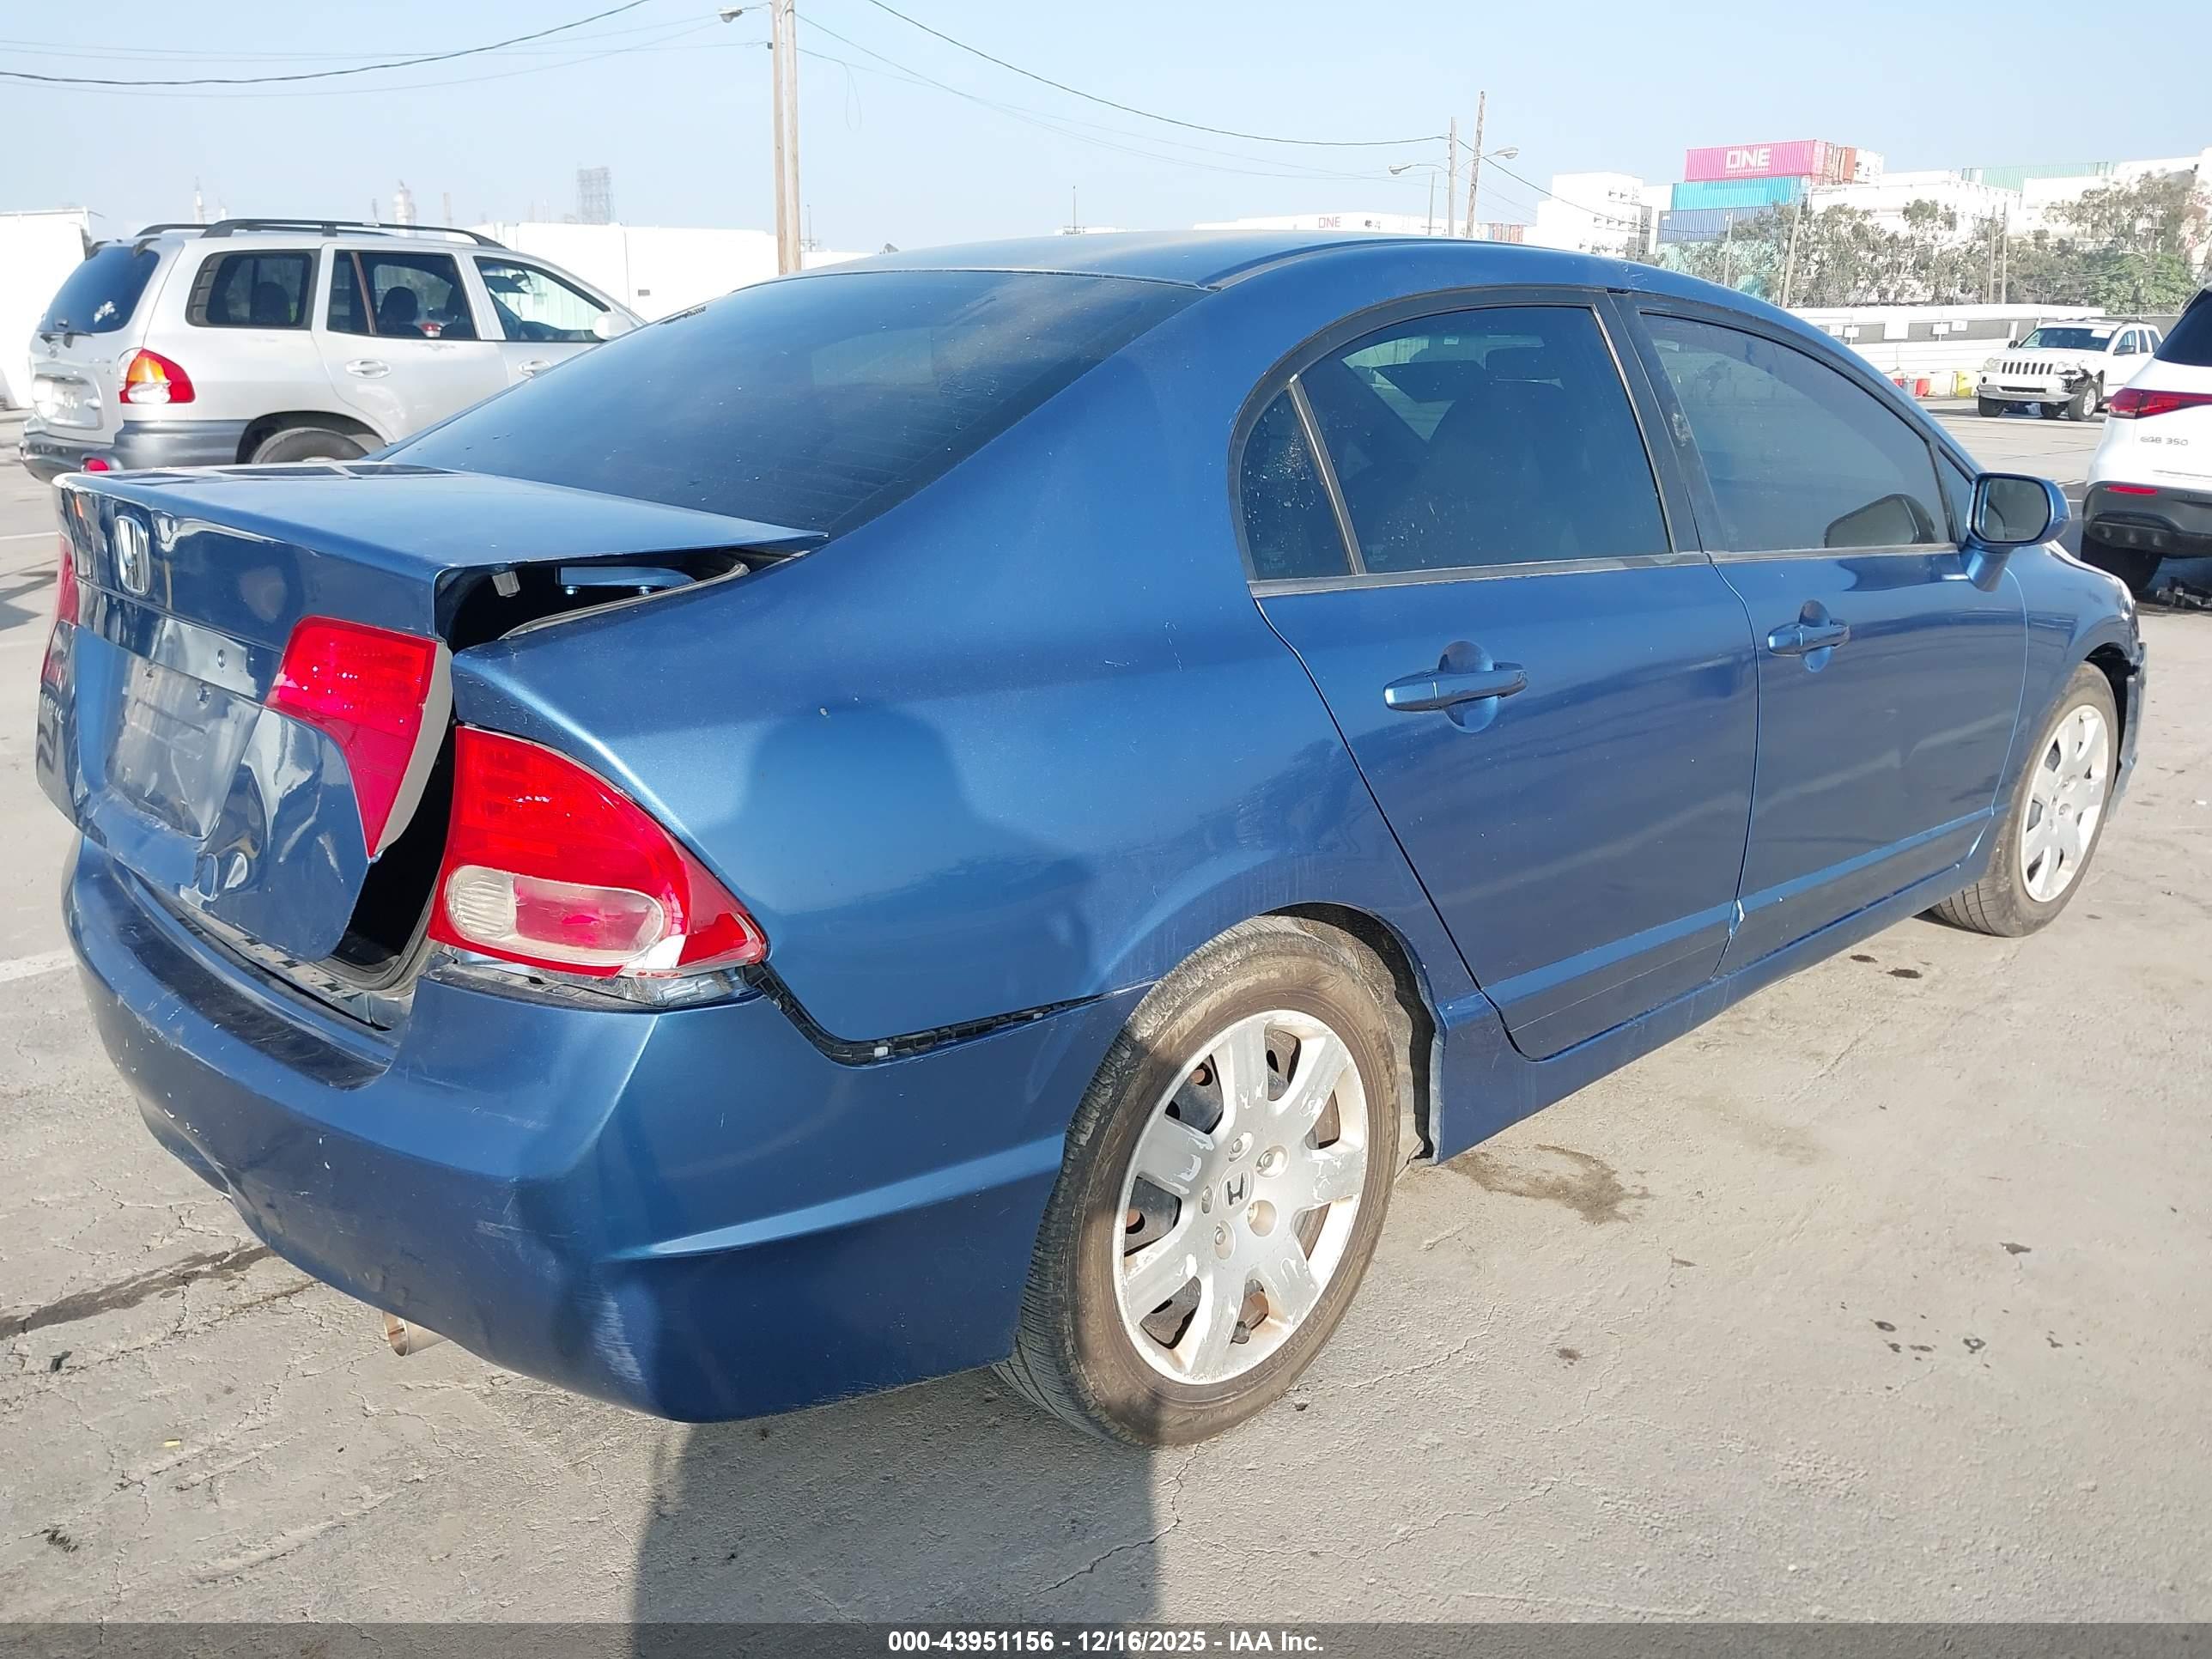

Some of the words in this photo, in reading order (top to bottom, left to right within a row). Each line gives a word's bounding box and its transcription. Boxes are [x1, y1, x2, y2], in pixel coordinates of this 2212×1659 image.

[1726, 149, 1771, 168] ONE
[1318, 216, 1340, 228] ONE
[2165, 437, 2189, 447] 350
